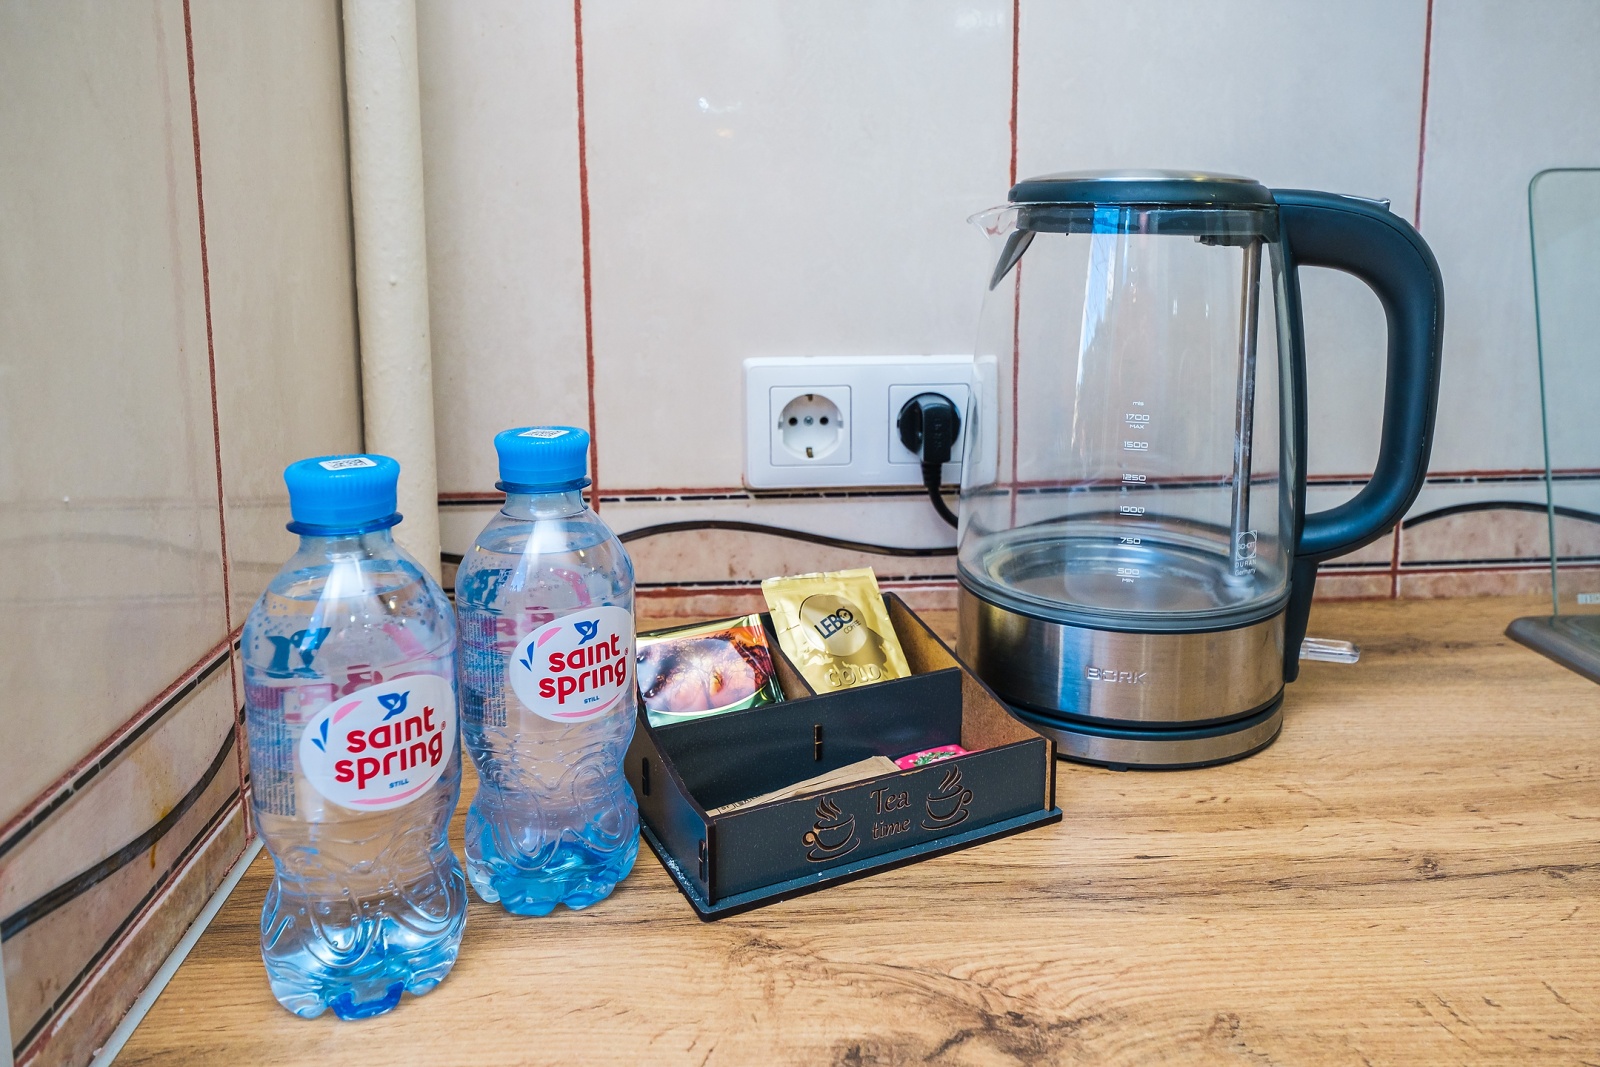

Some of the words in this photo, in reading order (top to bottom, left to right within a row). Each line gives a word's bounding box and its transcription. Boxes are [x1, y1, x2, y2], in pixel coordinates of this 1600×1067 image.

[1125, 413, 1150, 421] 1700
[1122, 473, 1147, 481] 1250
[1120, 505, 1145, 513] 1000
[1120, 537, 1141, 545] 750
[1117, 567, 1140, 575] 500
[1235, 559, 1257, 569] DURAN
[813, 607, 854, 640] LEBO
[843, 619, 862, 635] COFFEE
[548, 633, 620, 673] saint
[538, 656, 627, 705] spring
[824, 663, 882, 688] GOLD
[1085, 665, 1147, 685] BORK
[583, 695, 600, 704] STILL
[346, 705, 435, 753] saint
[334, 731, 443, 790] spring
[388, 778, 410, 789] STILL
[869, 787, 912, 815] Tea
[872, 818, 911, 840] time
